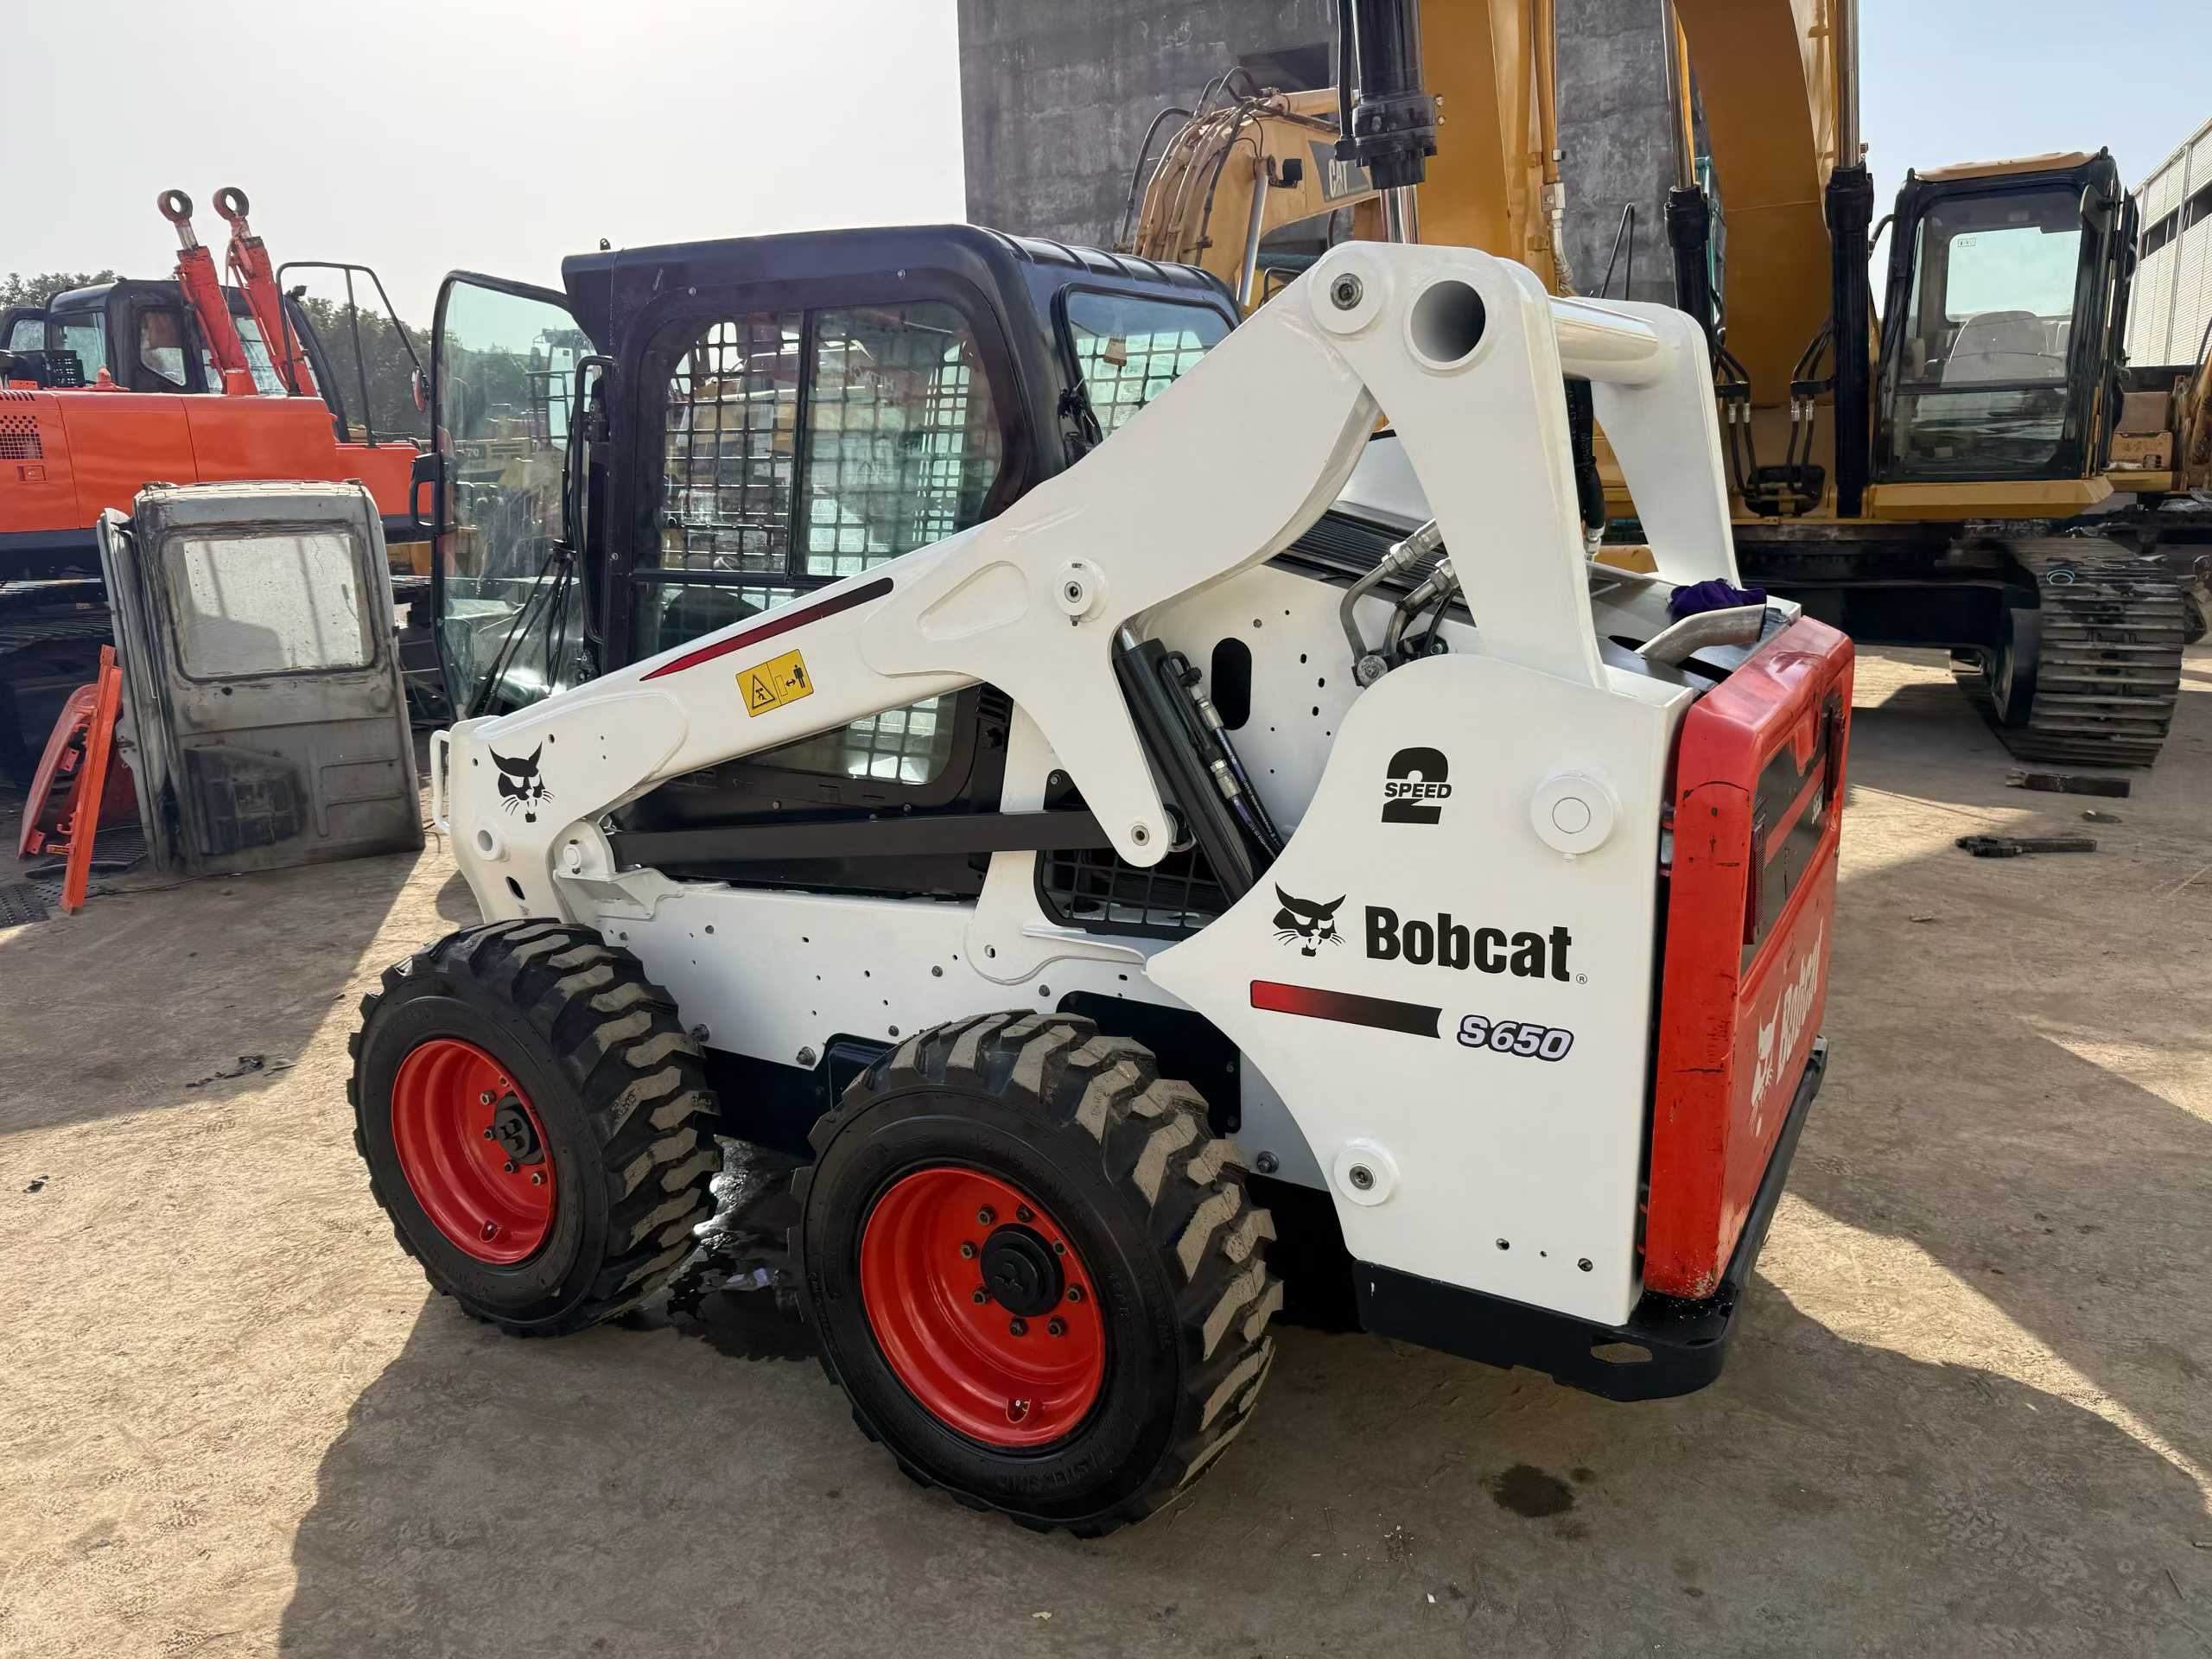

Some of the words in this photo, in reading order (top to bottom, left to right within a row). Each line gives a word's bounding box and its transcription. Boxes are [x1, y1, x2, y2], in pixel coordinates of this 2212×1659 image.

[1328, 158, 1348, 199] CAT
[1381, 747, 1449, 825] 2
[1384, 782, 1452, 799] SPEED
[1364, 905, 1573, 982] Bobcat
[1456, 1014, 1574, 1062] S650
